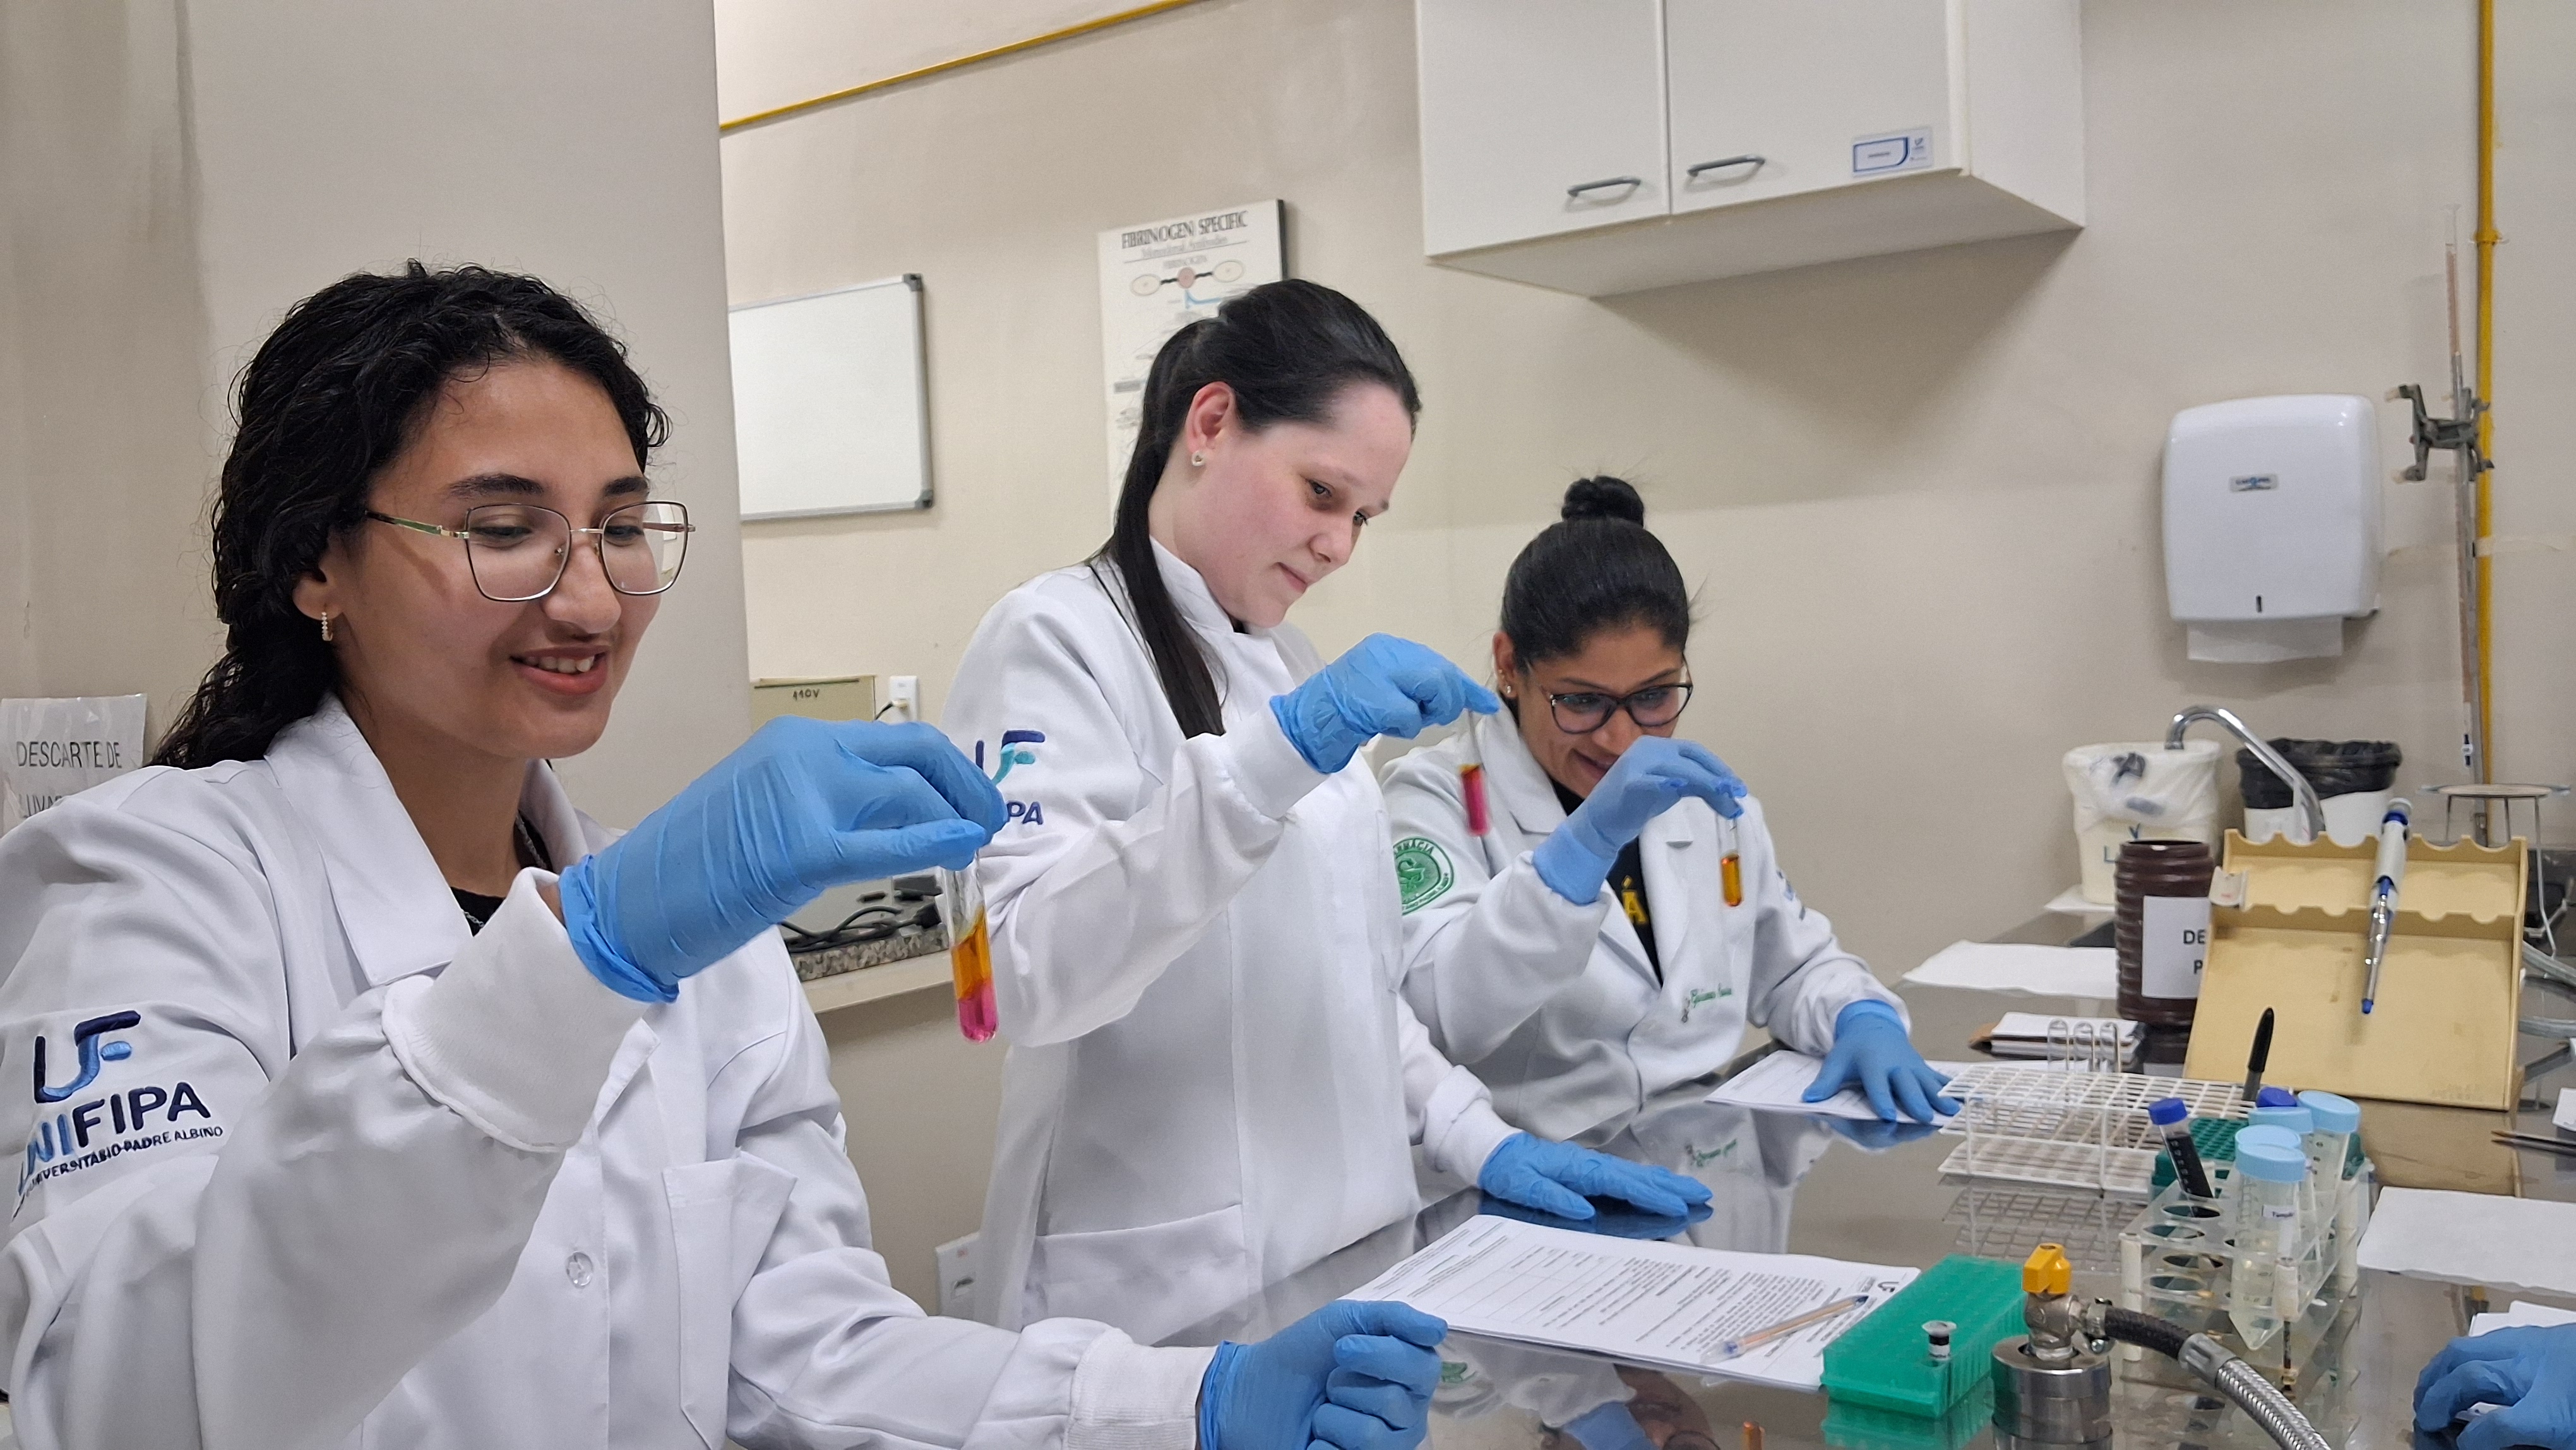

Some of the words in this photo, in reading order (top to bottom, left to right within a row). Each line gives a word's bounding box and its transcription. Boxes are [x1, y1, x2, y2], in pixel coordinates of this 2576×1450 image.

[1122, 220, 1195, 249] FIBRINOGEN
[1198, 210, 1248, 234] SPECIFIC
[16, 741, 103, 768] DESCARTE
[107, 741, 122, 768] DE
[124, 1131, 171, 1152] PADRE
[174, 1126, 223, 1141] ALBINO
